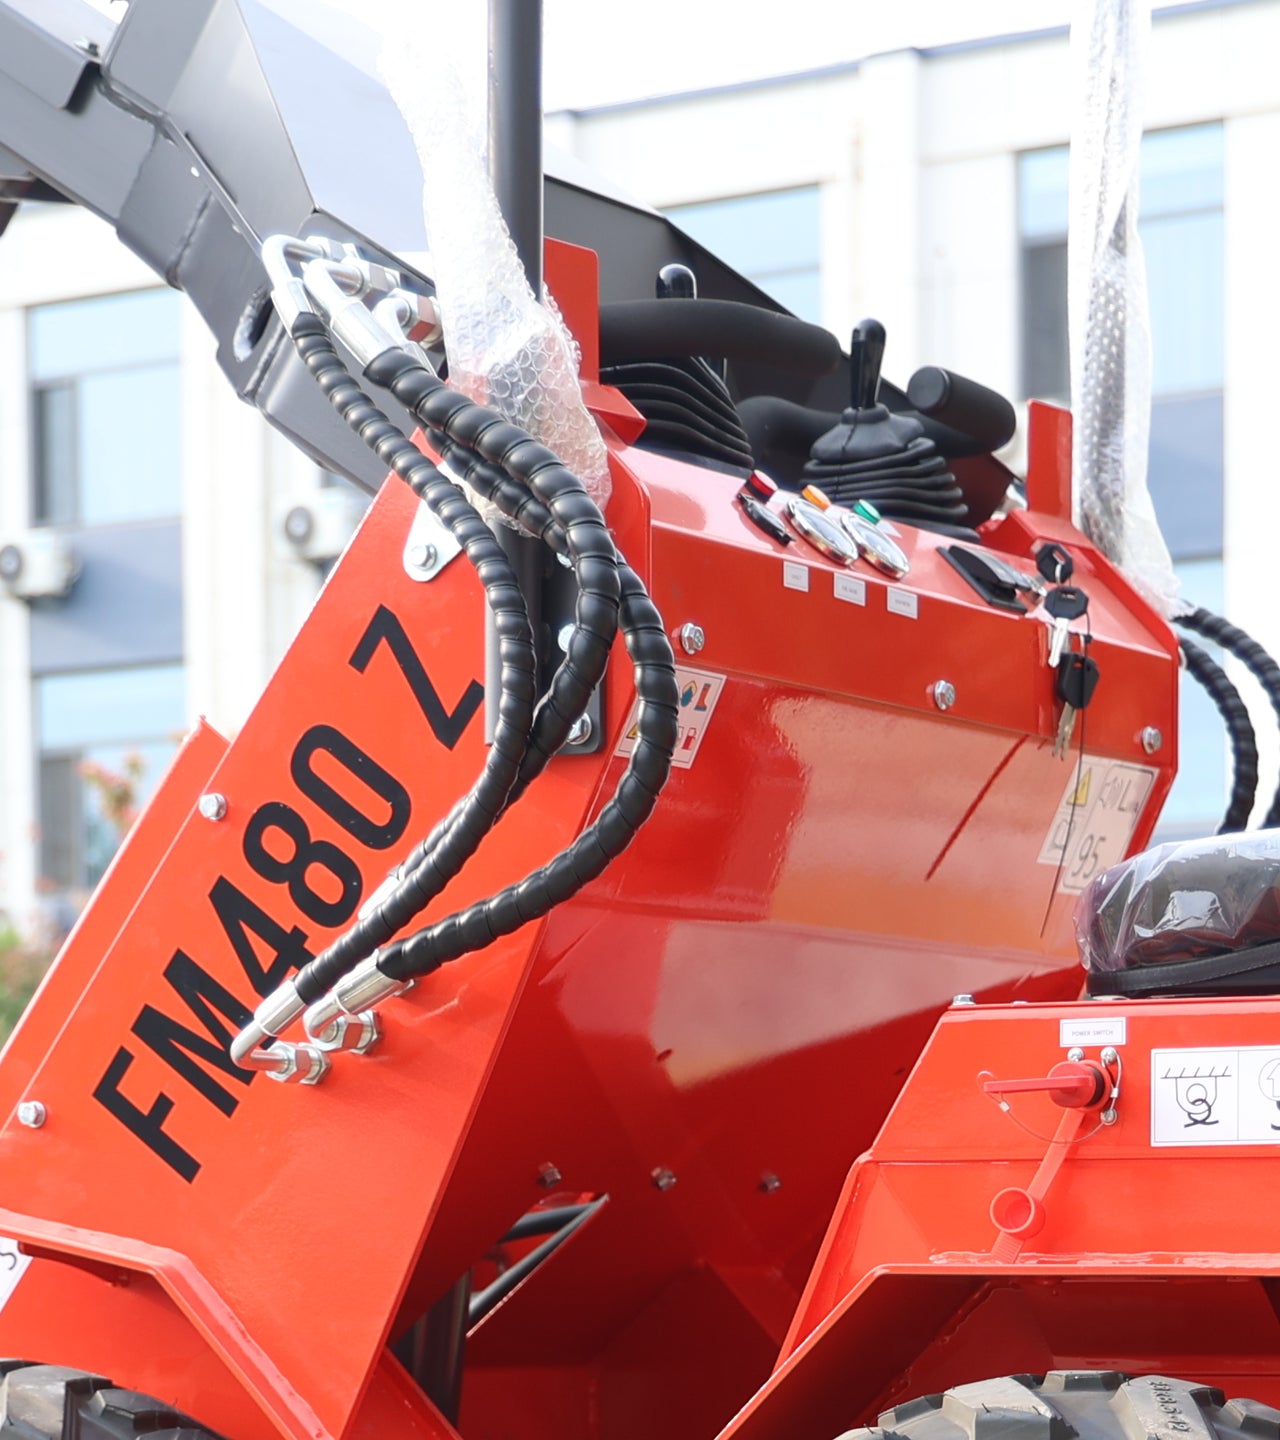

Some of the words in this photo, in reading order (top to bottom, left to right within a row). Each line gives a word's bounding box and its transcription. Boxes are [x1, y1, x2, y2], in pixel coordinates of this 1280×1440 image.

[93, 724, 411, 1183] FM480
[350, 605, 484, 750] Z
[1071, 834, 1106, 879] 95
